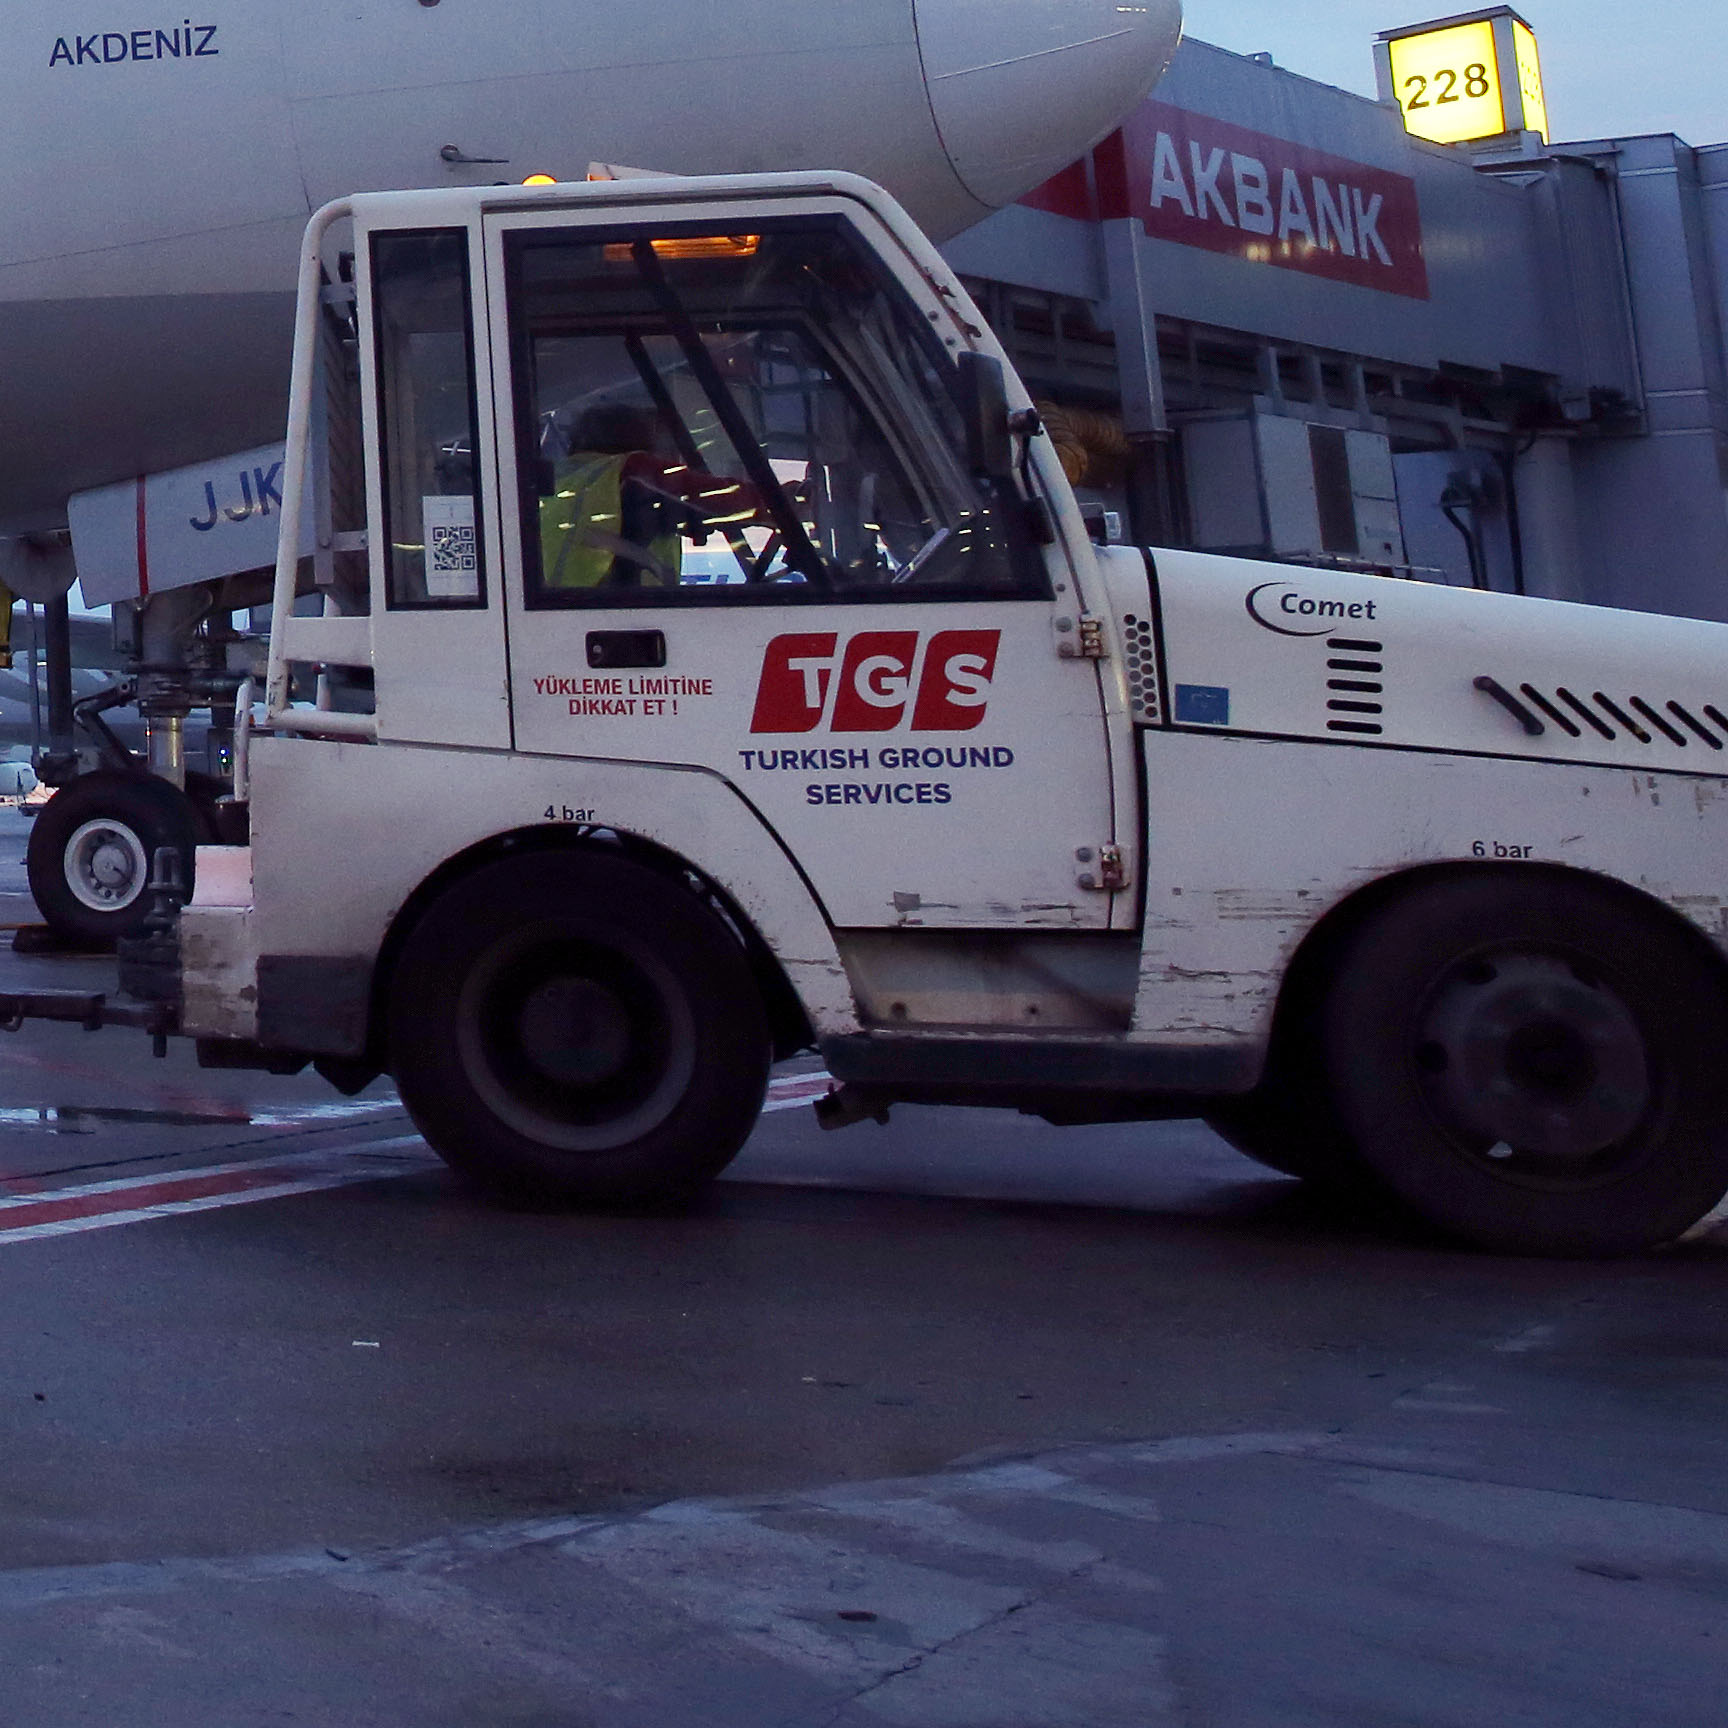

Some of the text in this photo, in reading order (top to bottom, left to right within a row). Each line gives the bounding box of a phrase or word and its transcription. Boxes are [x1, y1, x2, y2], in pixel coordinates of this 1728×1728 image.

[49, 19, 219, 68] AKDENİZ
[1404, 62, 1490, 110] 228
[1149, 131, 1394, 267] AKBANK
[1280, 591, 1377, 621] Comet
[534, 675, 713, 696] YÜKLEME LİMİTİNE
[569, 696, 637, 715] DİKKAT
[644, 699, 666, 715] ET
[739, 747, 1014, 770] TURKISH GROUND
[806, 783, 952, 805] SERVICES
[544, 805, 595, 821] 4 bar
[1472, 840, 1534, 859] 6 bar
